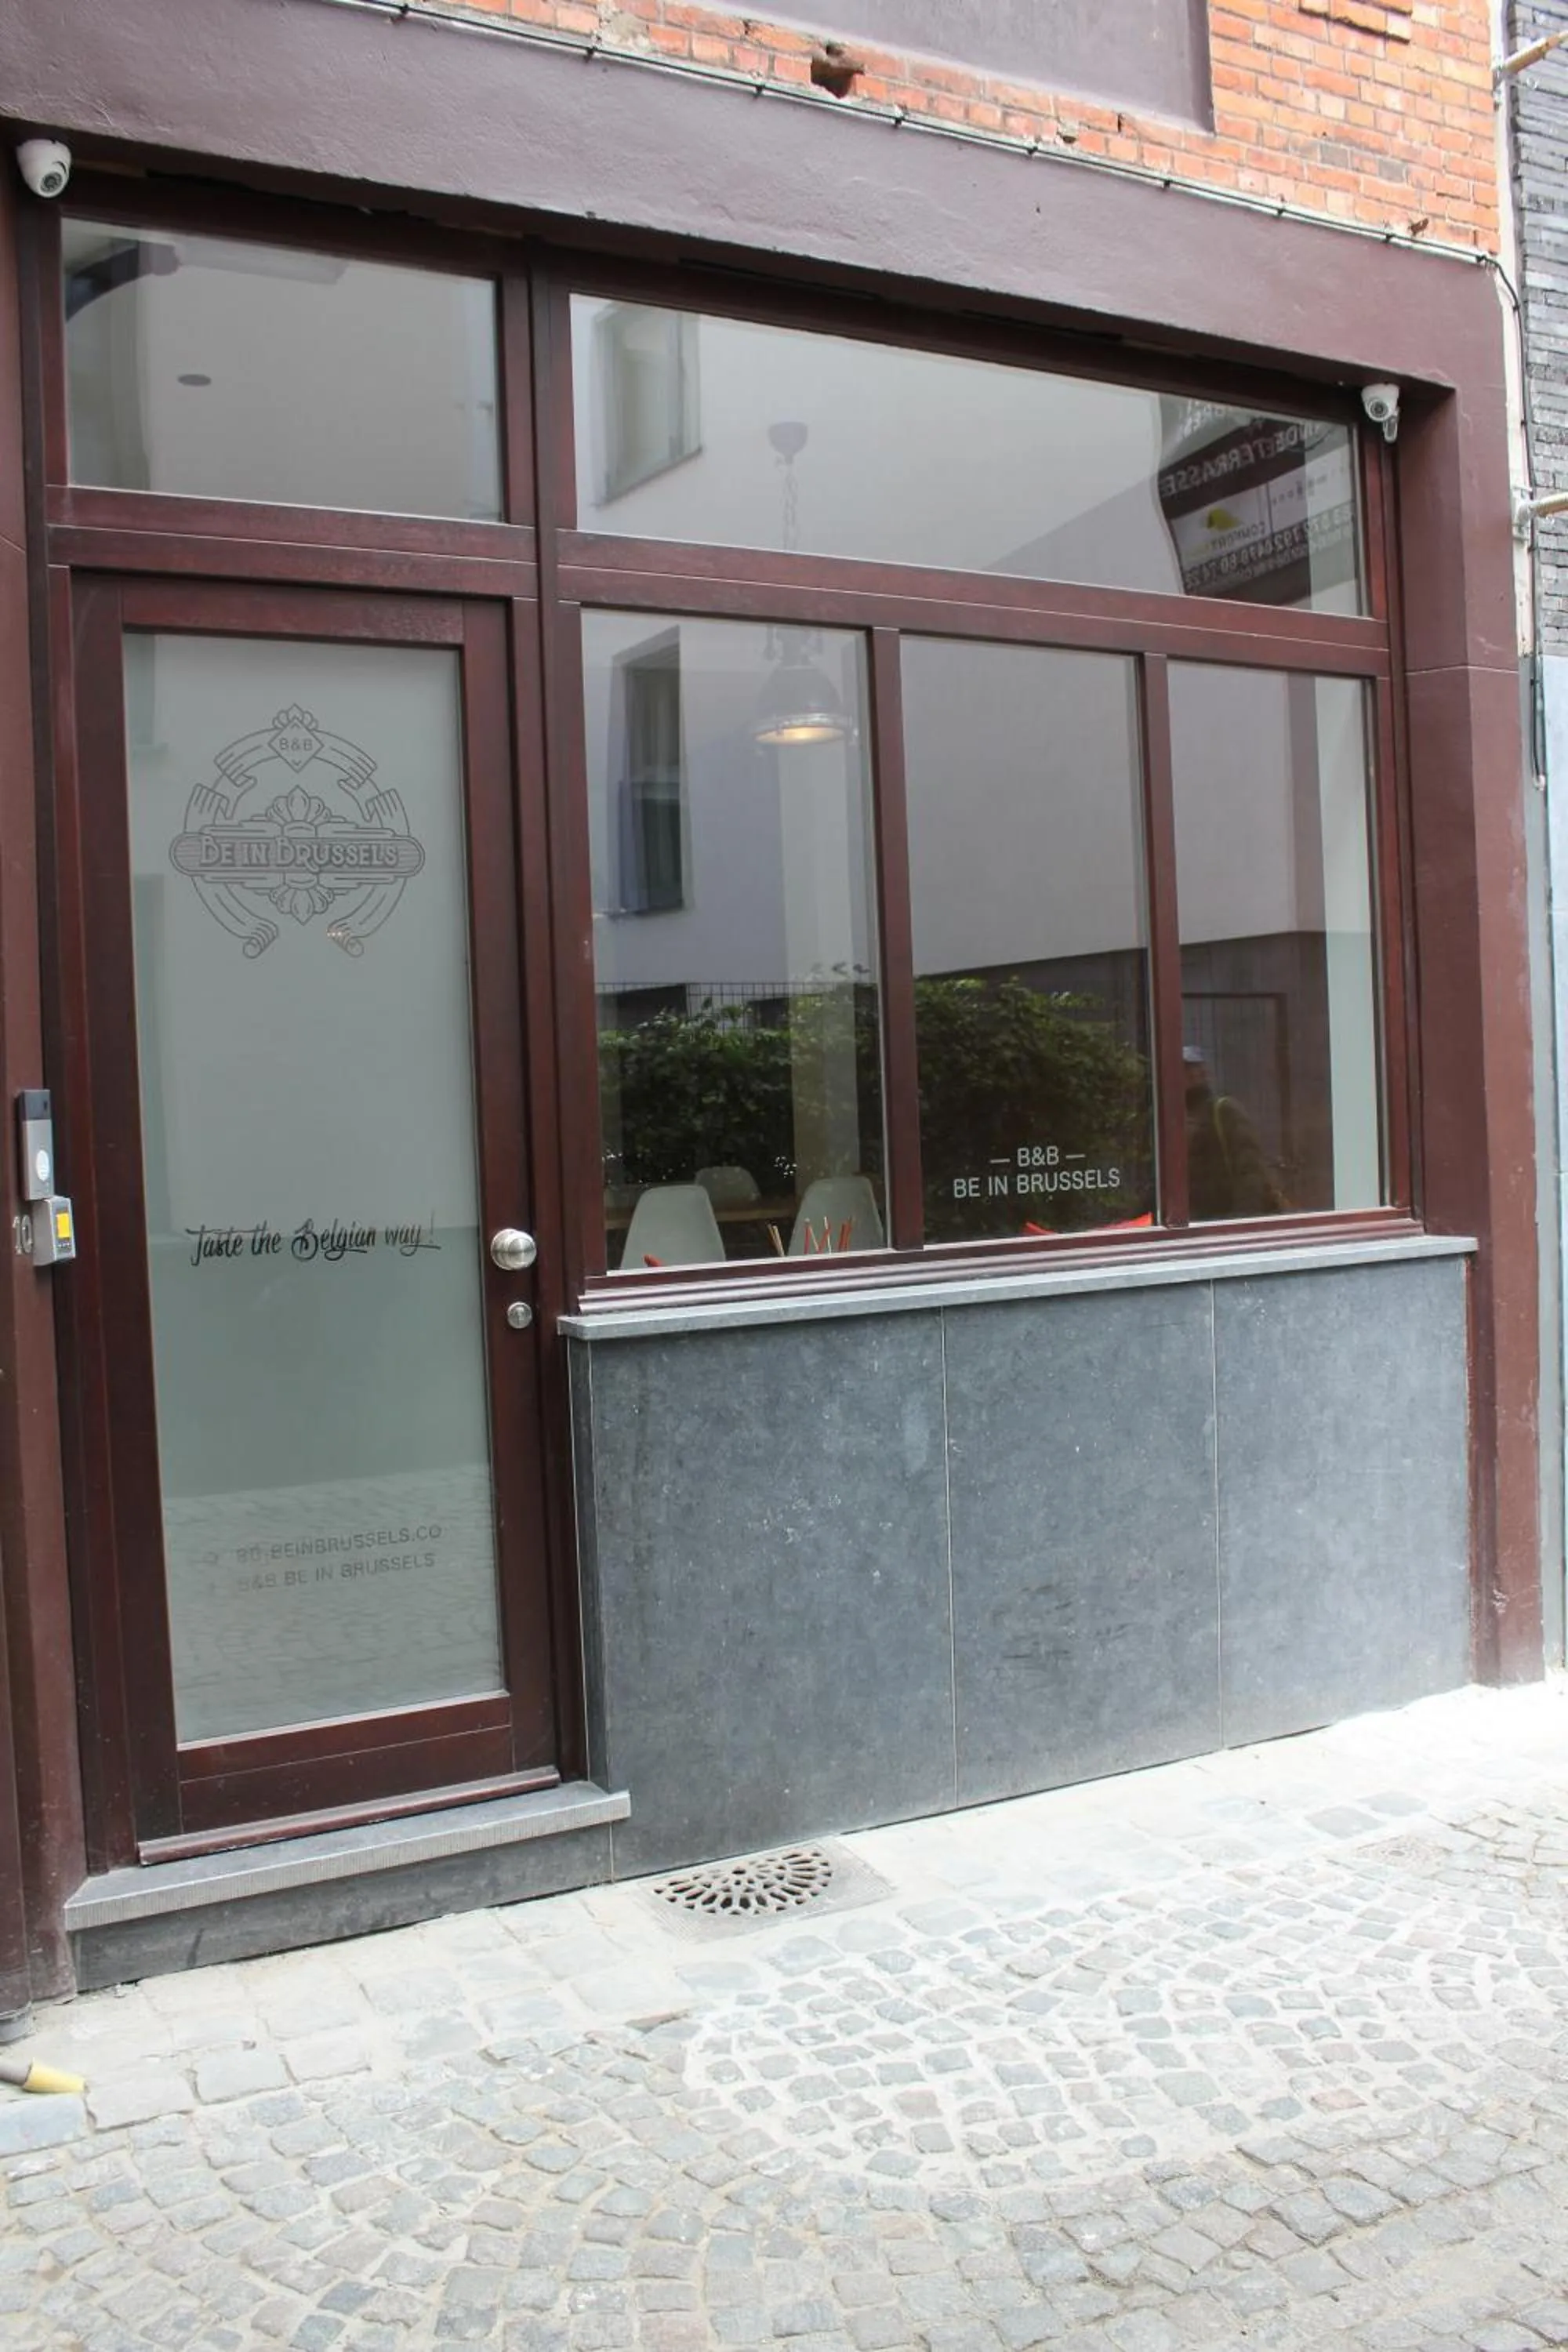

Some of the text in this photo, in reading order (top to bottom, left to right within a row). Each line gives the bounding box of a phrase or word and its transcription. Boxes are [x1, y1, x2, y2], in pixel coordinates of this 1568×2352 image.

[278, 737, 313, 752] B&B
[241, 841, 270, 867] IN
[274, 835, 399, 874] BRUSSELS
[1017, 1145, 1059, 1167] B&B
[953, 1167, 1121, 1199] BE IN BRUSSELS
[185, 1225, 245, 1266] Taste
[251, 1220, 283, 1256] the
[291, 1218, 376, 1261] Belgian
[283, 1570, 308, 1588] BE
[315, 1564, 334, 1582] IN
[340, 1552, 437, 1580] BRUSSELS
